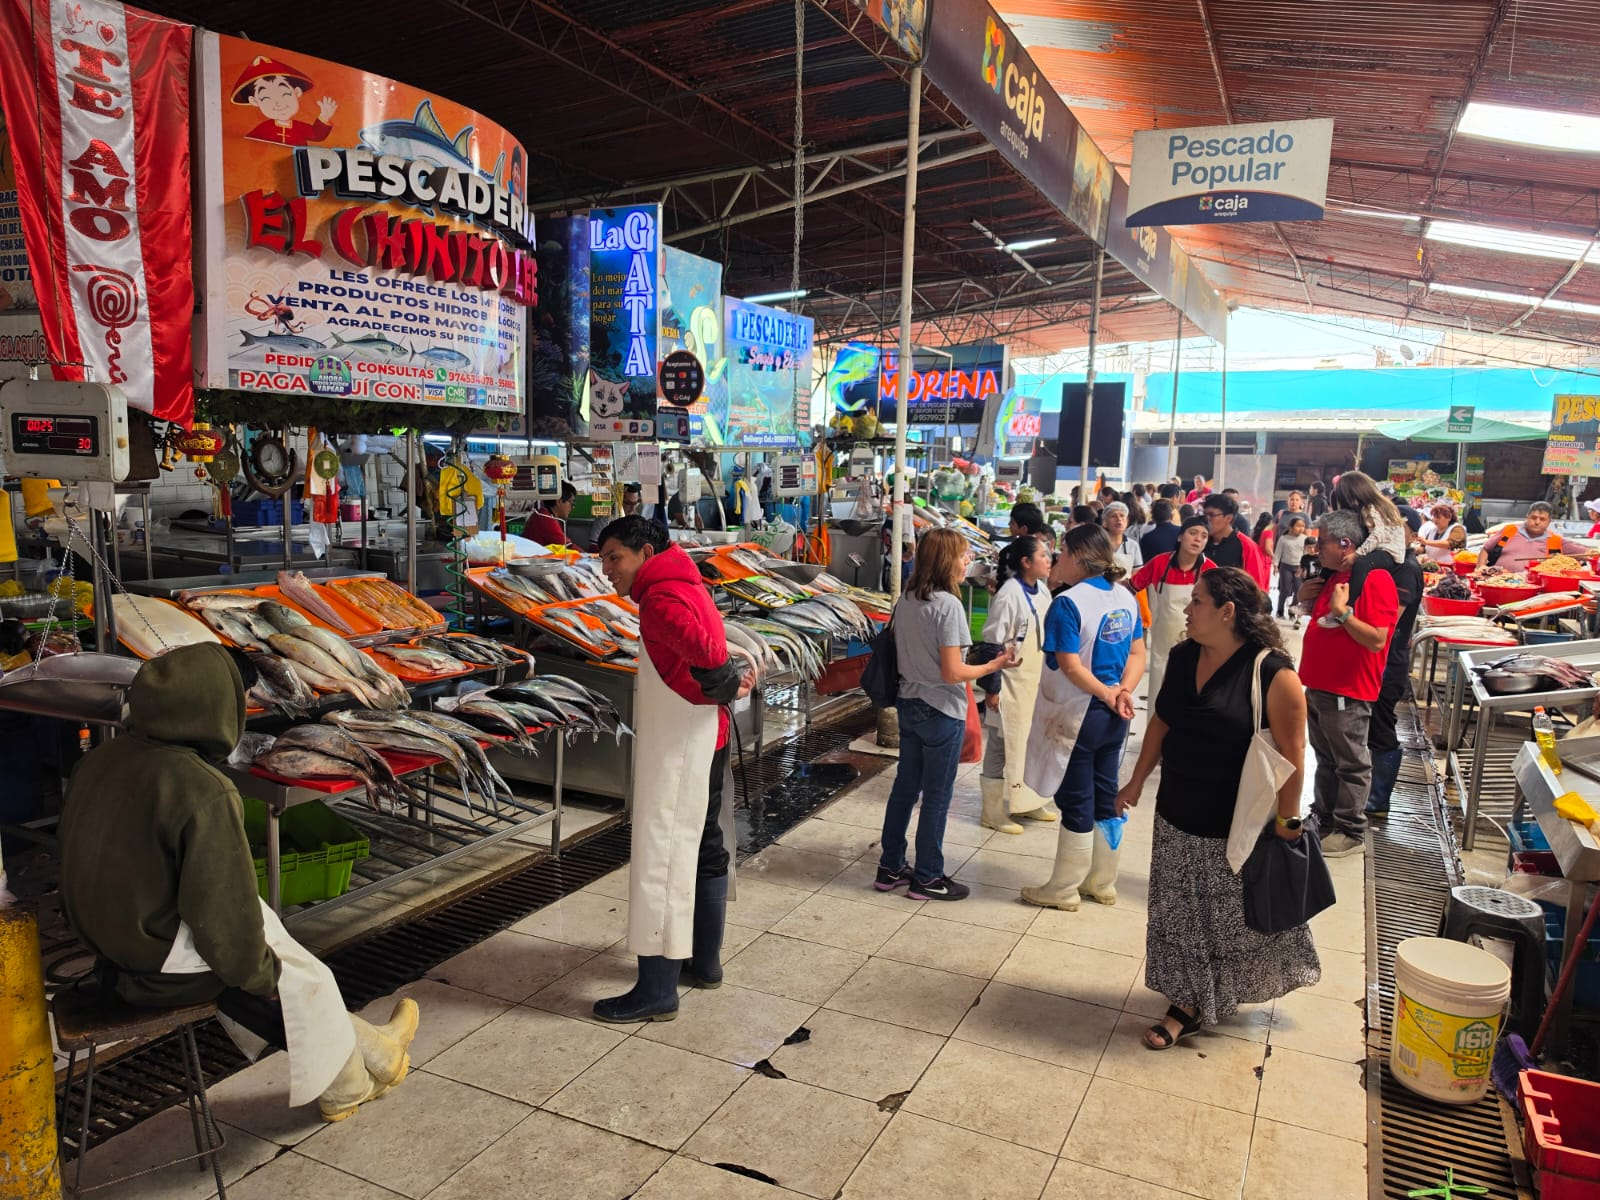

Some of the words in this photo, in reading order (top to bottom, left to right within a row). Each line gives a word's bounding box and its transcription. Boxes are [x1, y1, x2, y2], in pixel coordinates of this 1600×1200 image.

[1000, 120, 1029, 160] arequipa
[1168, 129, 1294, 159] Pescado
[1171, 158, 1286, 189] Popular
[68, 138, 130, 241] AMO
[305, 147, 537, 252] PESCADERIA
[1214, 195, 1248, 212] caja
[241, 189, 323, 258] EL
[330, 206, 508, 291] CHINITO
[589, 218, 626, 251] La
[330, 269, 369, 284] LES
[375, 277, 447, 298] OFRECE
[451, 290, 478, 304] LOS
[592, 273, 603, 282] Lo
[592, 286, 605, 296] del
[298, 281, 429, 309] PRODUCTOS
[592, 301, 611, 310] para
[623, 210, 655, 378] GATA
[266, 294, 349, 314] VENTA
[356, 306, 384, 318] AL
[390, 310, 430, 324] POR
[435, 318, 486, 335] MAYOR
[327, 316, 437, 338] AGRADECEMOS
[440, 331, 454, 340] SU
[592, 314, 616, 325] hogar
[741, 312, 809, 350] PESCADERIA
[240, 371, 308, 391] PAGA
[374, 382, 421, 399] CON:
[357, 362, 434, 379] CONSULTAS
[880, 369, 999, 401] MORENA
[428, 388, 443, 396] VISA
[78, 438, 91, 449] 30
